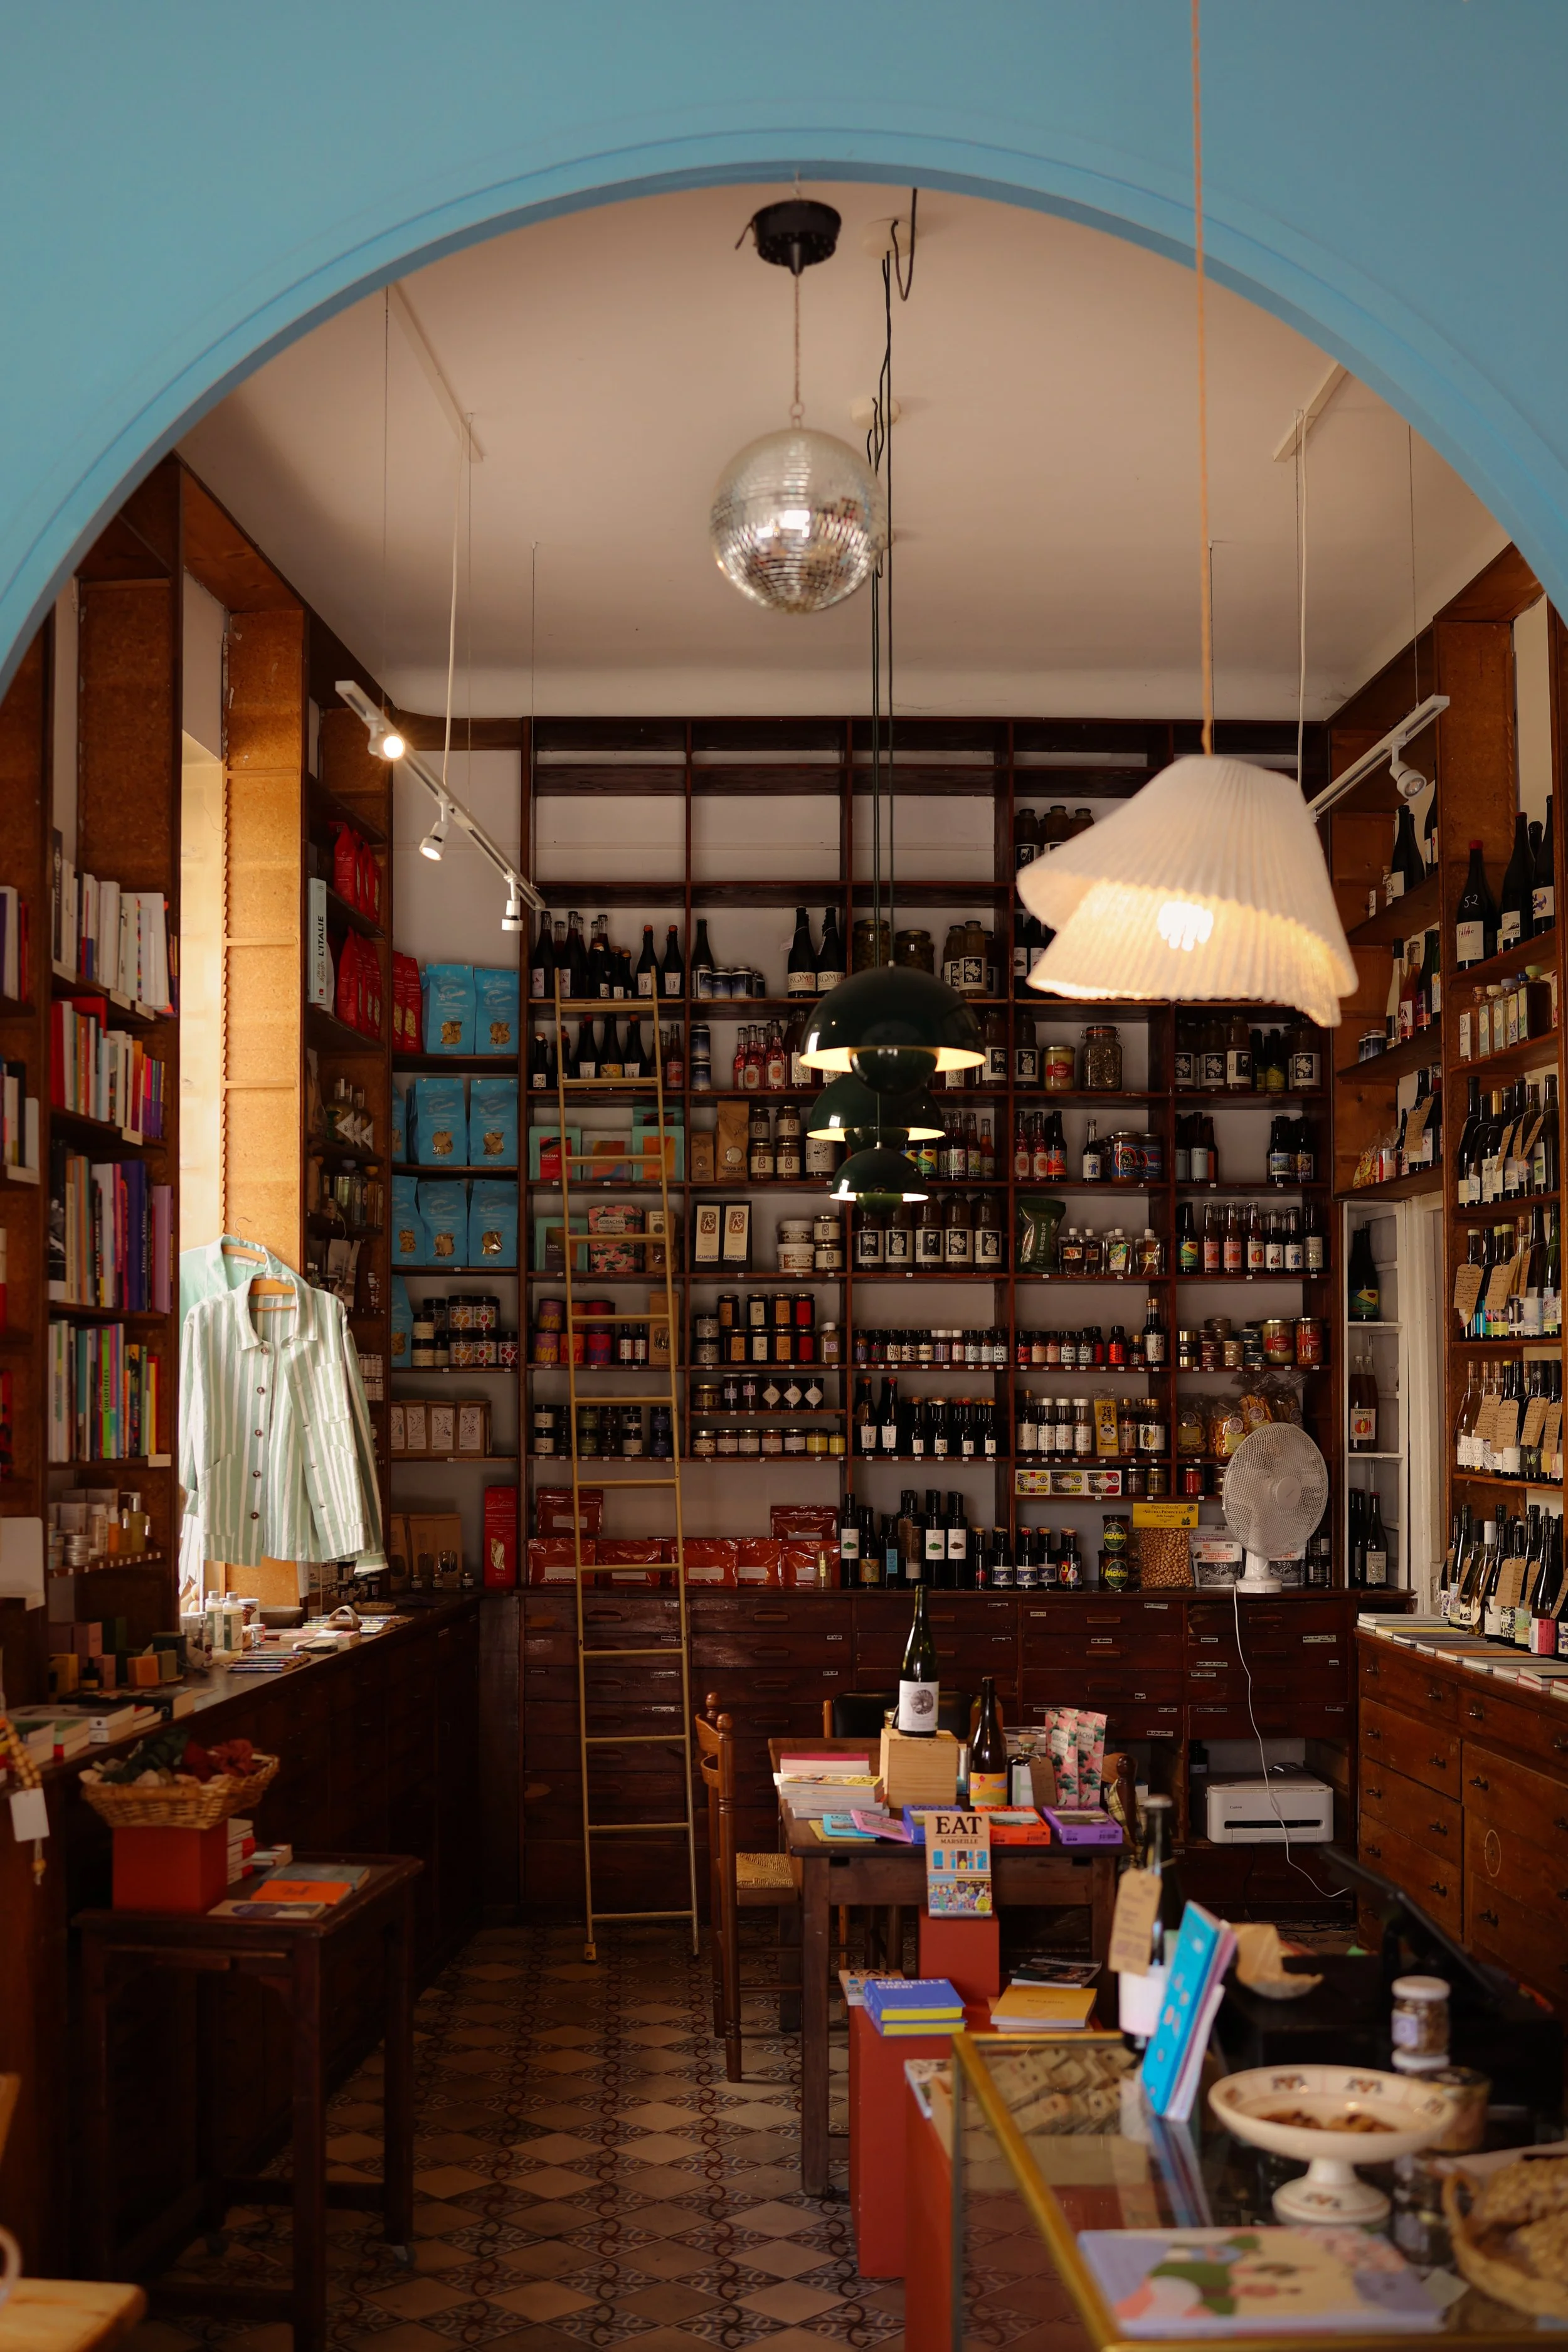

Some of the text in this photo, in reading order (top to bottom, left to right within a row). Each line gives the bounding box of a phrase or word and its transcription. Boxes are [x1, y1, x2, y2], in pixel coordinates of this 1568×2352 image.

[1464, 894, 1479, 908] 52
[935, 1816, 982, 1835] EAT
[850, 1970, 893, 1978] EAT
